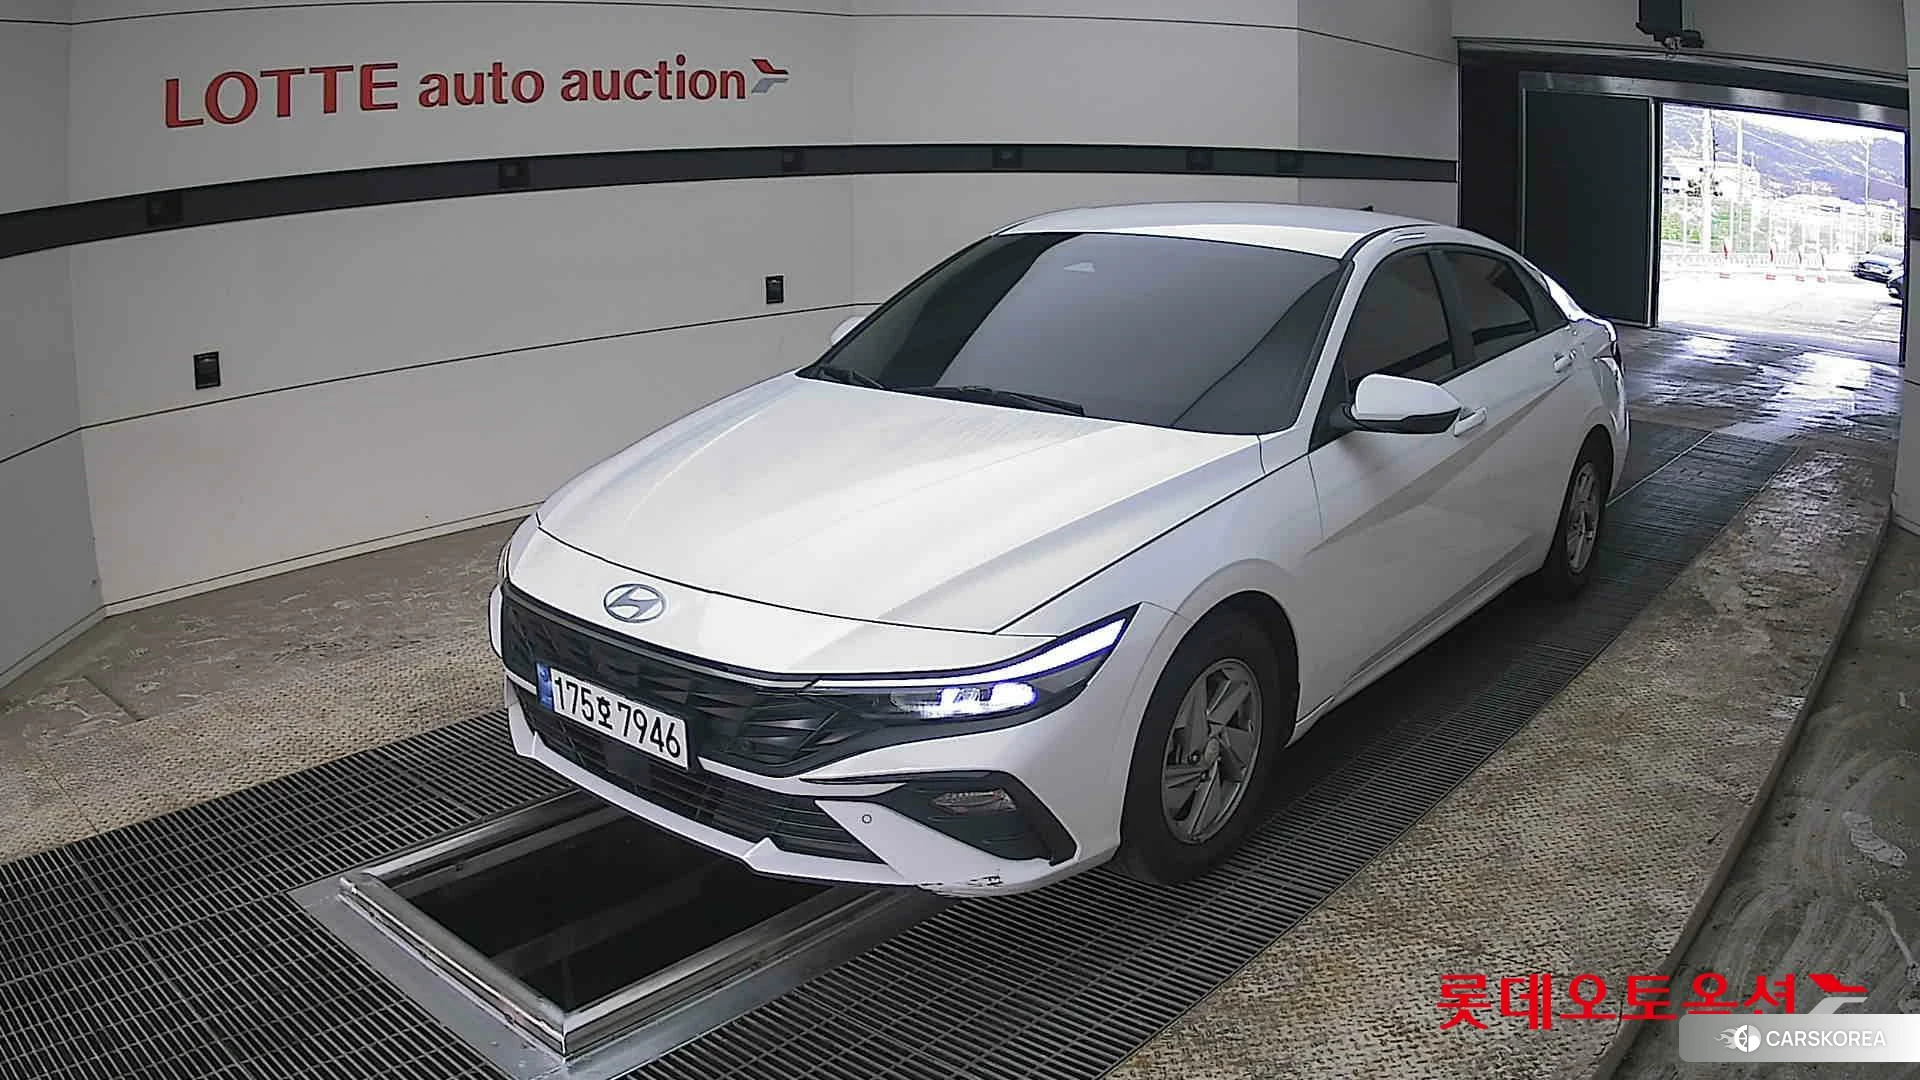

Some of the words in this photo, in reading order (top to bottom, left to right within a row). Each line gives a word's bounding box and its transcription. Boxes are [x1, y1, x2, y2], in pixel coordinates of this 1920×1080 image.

[165, 62, 398, 128] LOTTE
[418, 61, 545, 108] auto
[560, 53, 747, 101] auction
